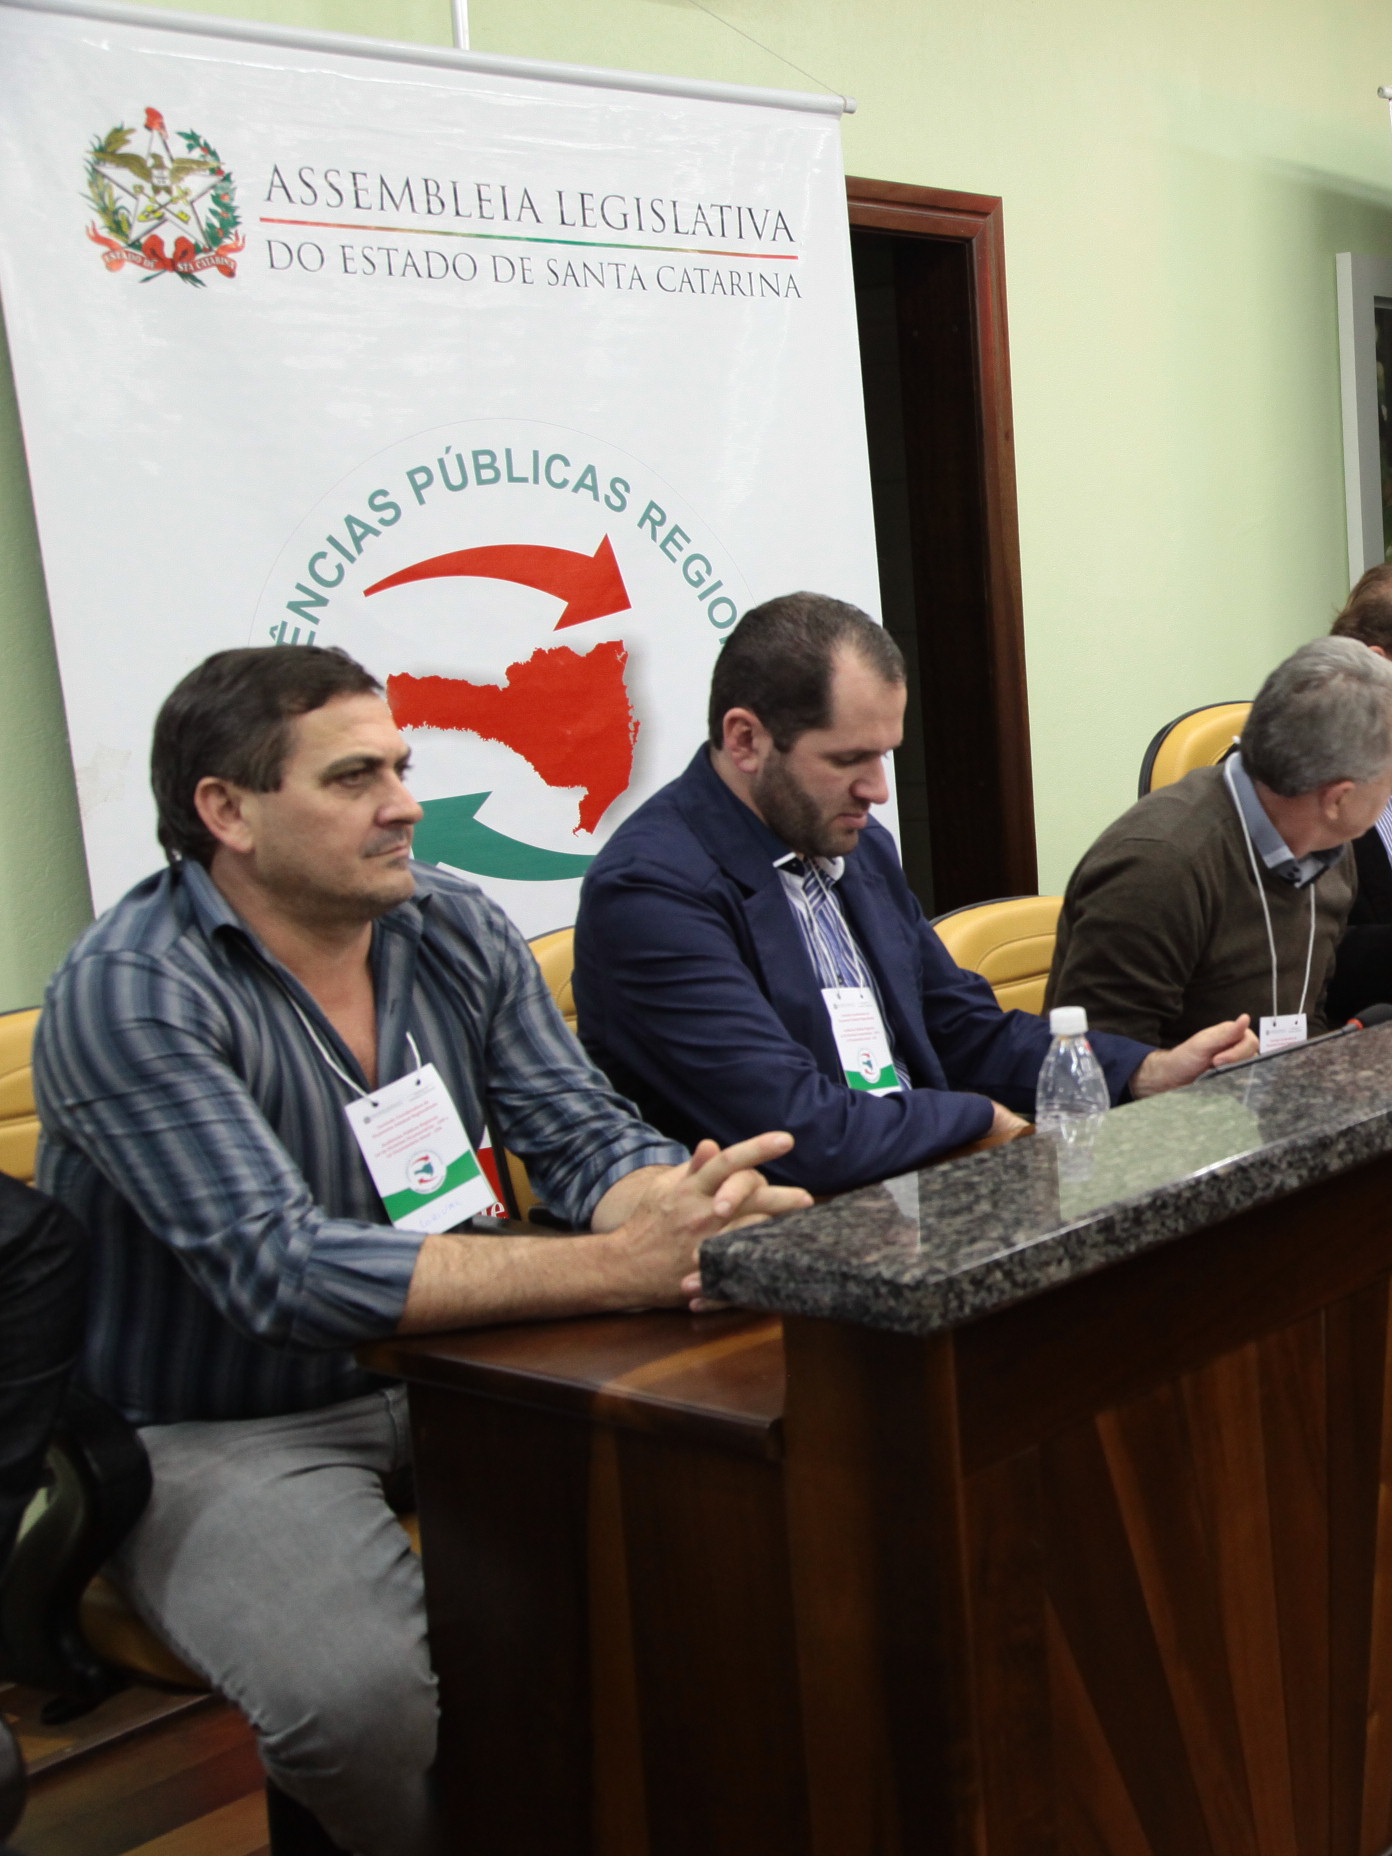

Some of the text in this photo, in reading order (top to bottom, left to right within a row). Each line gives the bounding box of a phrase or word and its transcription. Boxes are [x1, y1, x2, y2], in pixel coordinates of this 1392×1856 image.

[264, 163, 797, 242] ASSEMBLEIA LEGISLATIVA
[265, 239, 803, 299] DO ESTADO DE SANTA CATARINA
[406, 445, 631, 513] PÚBLICAS
[637, 500, 738, 644] REGIO
